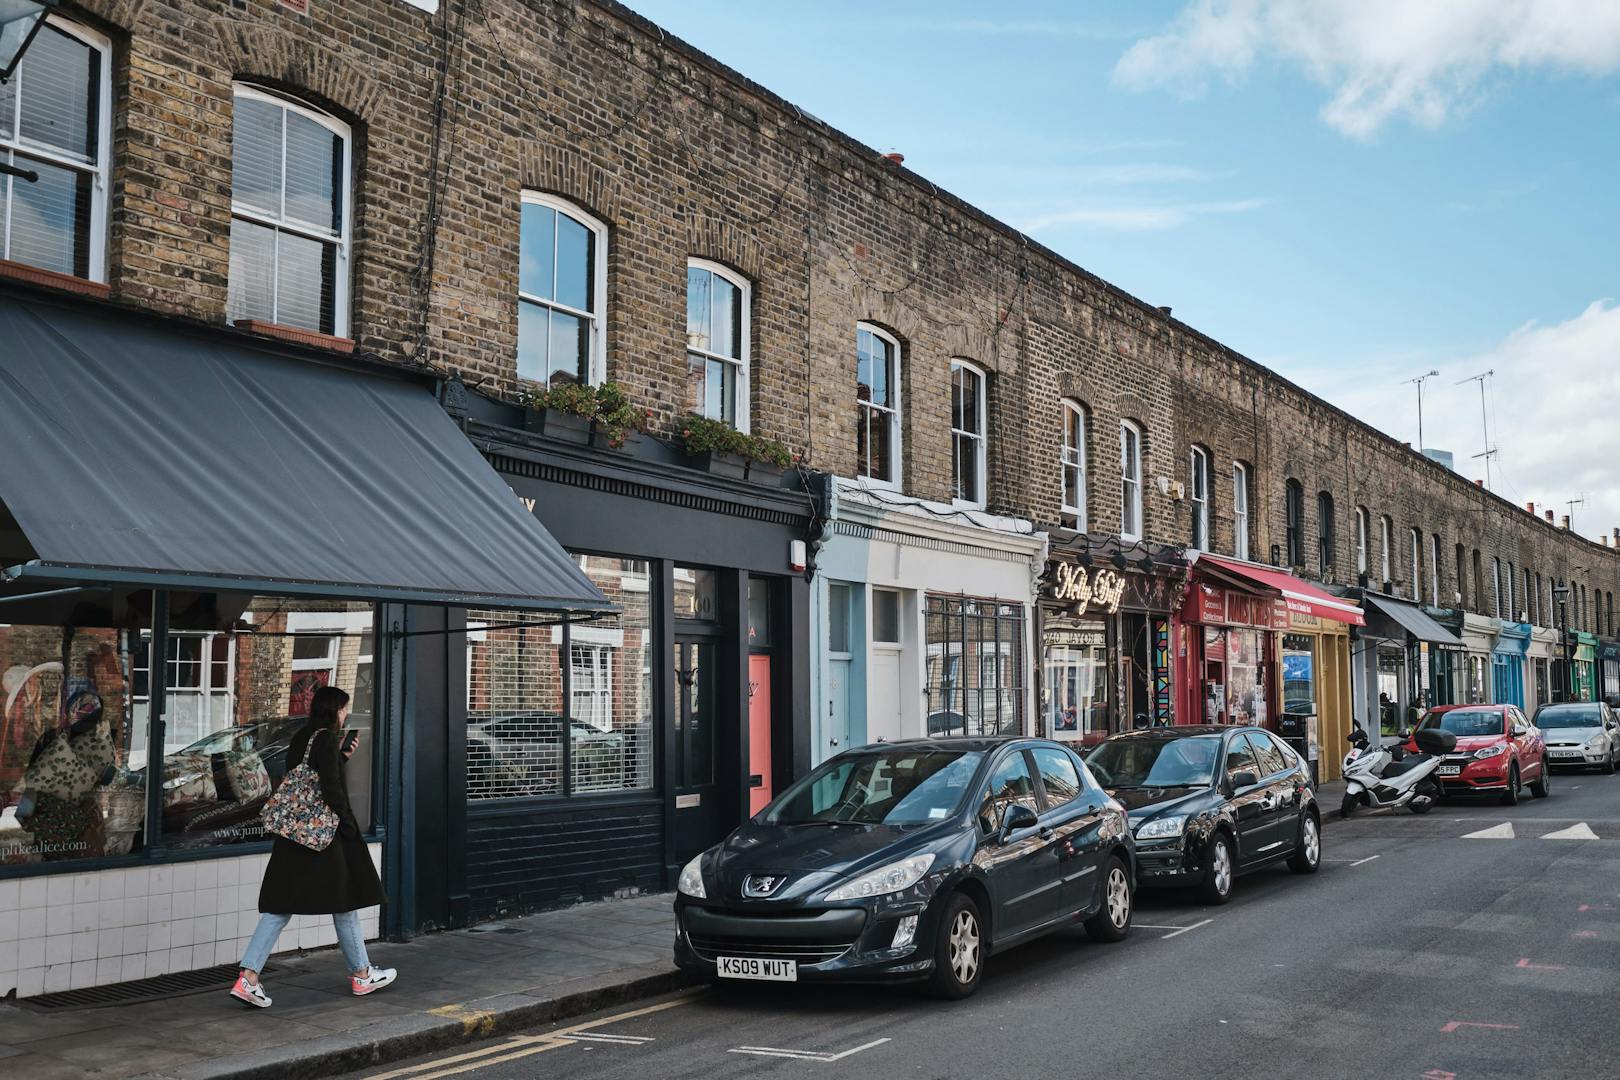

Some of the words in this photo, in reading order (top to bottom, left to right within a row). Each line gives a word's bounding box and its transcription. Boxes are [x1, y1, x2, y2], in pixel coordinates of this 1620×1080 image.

[1055, 561, 1093, 616] Nelly
[1092, 569, 1126, 614] Duff
[213, 825, 268, 838] www.jump
[0, 840, 87, 860] plikealice.com
[723, 958, 759, 975] KS09
[763, 960, 790, 977] WUT
